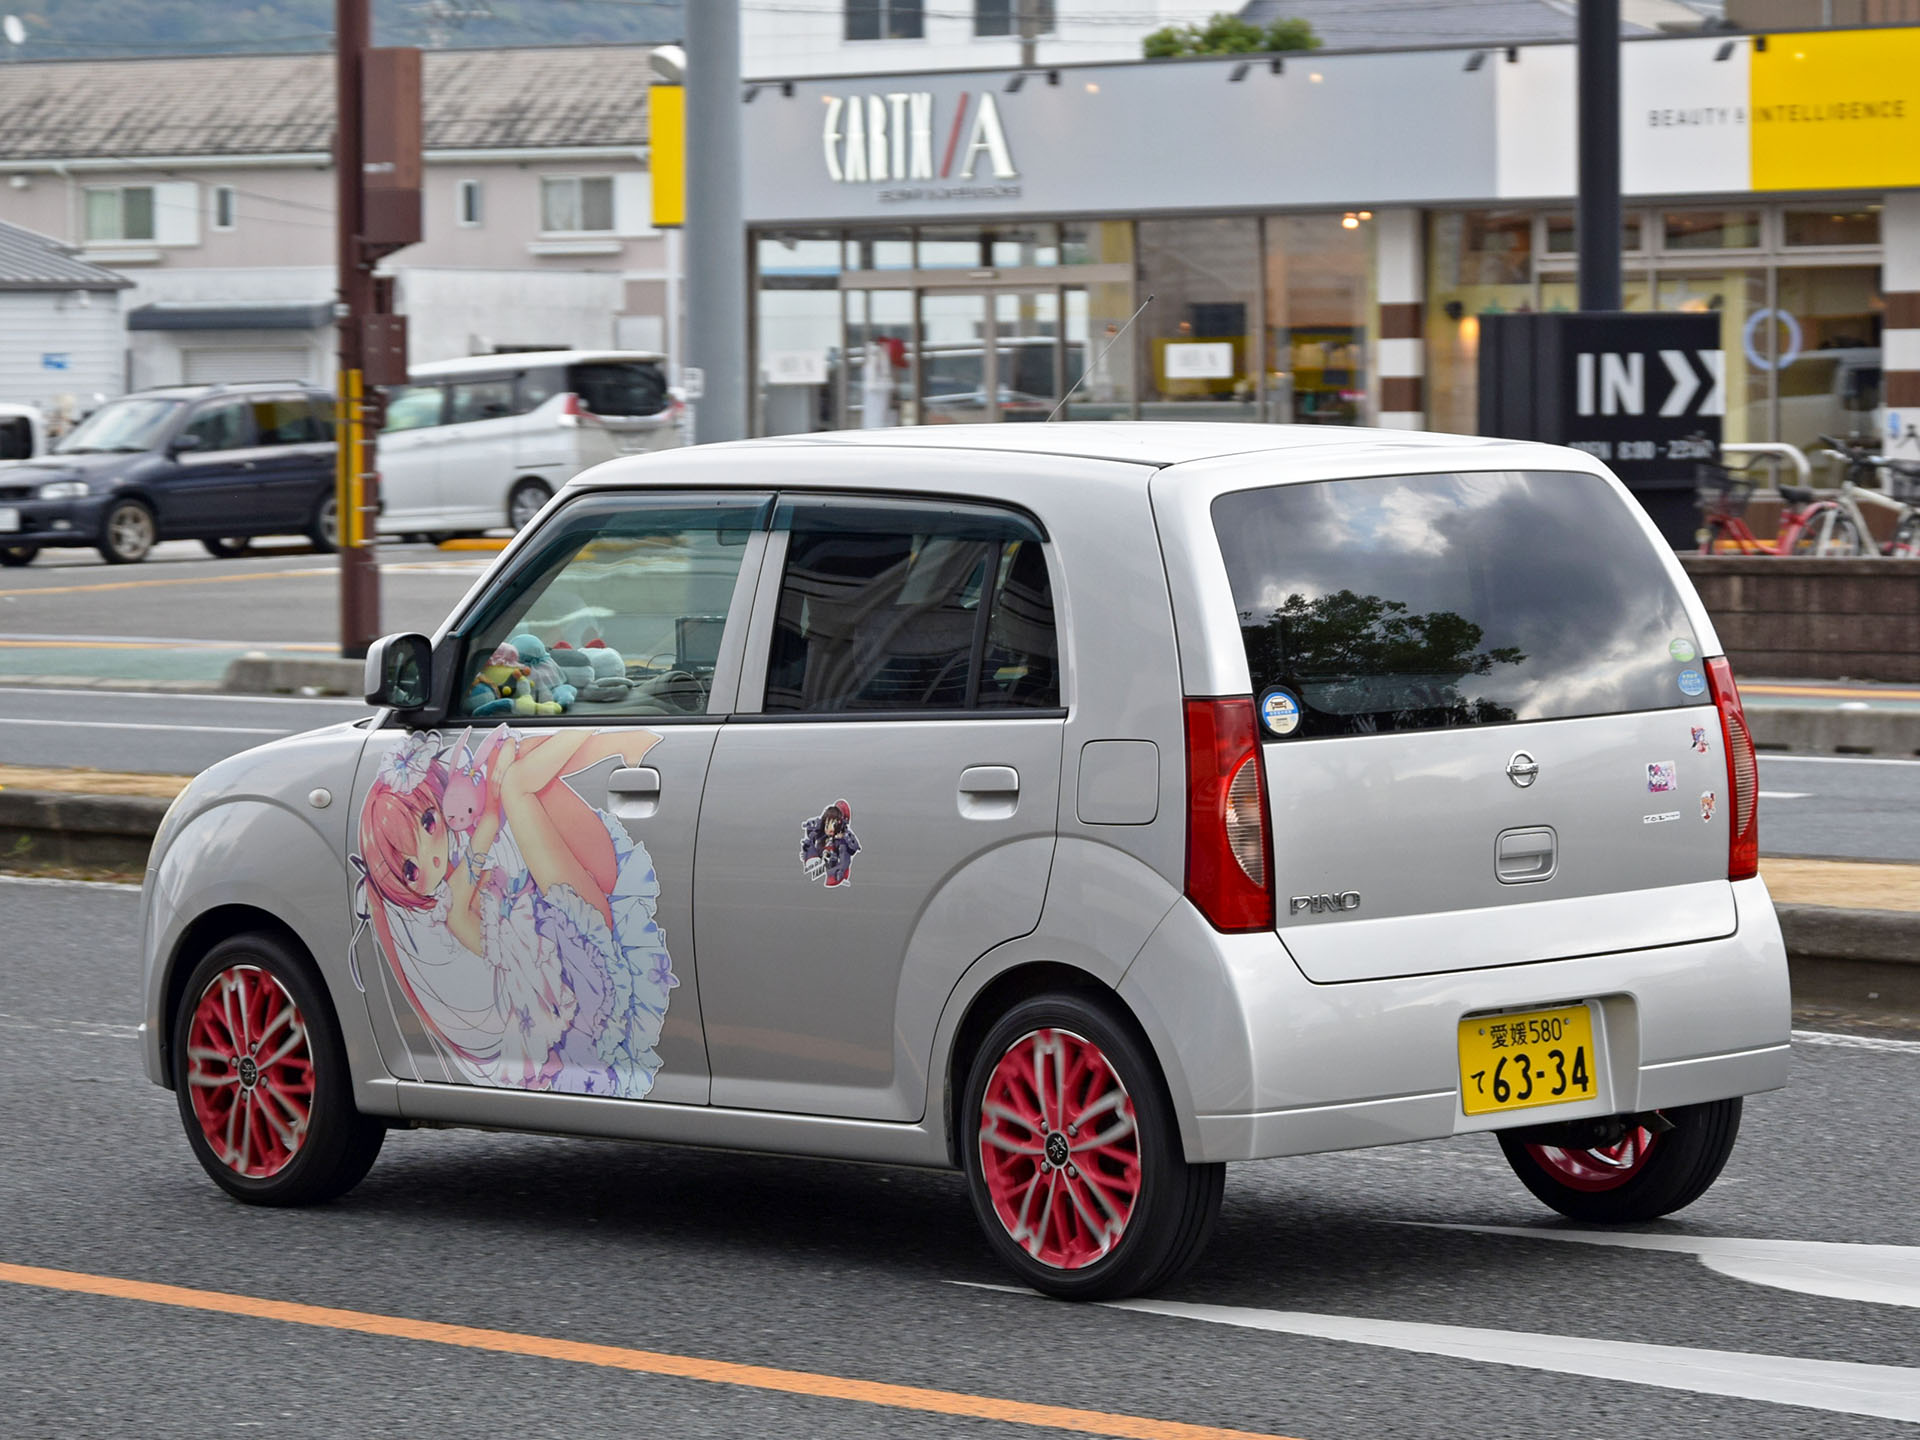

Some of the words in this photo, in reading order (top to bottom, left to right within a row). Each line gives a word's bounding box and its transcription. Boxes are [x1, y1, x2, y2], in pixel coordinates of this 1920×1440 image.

[1648, 107, 1728, 126] BEAUTY
[1577, 352, 1645, 416] IN
[1290, 890, 1361, 915] PINO
[1493, 1046, 1589, 1103] 63-34
